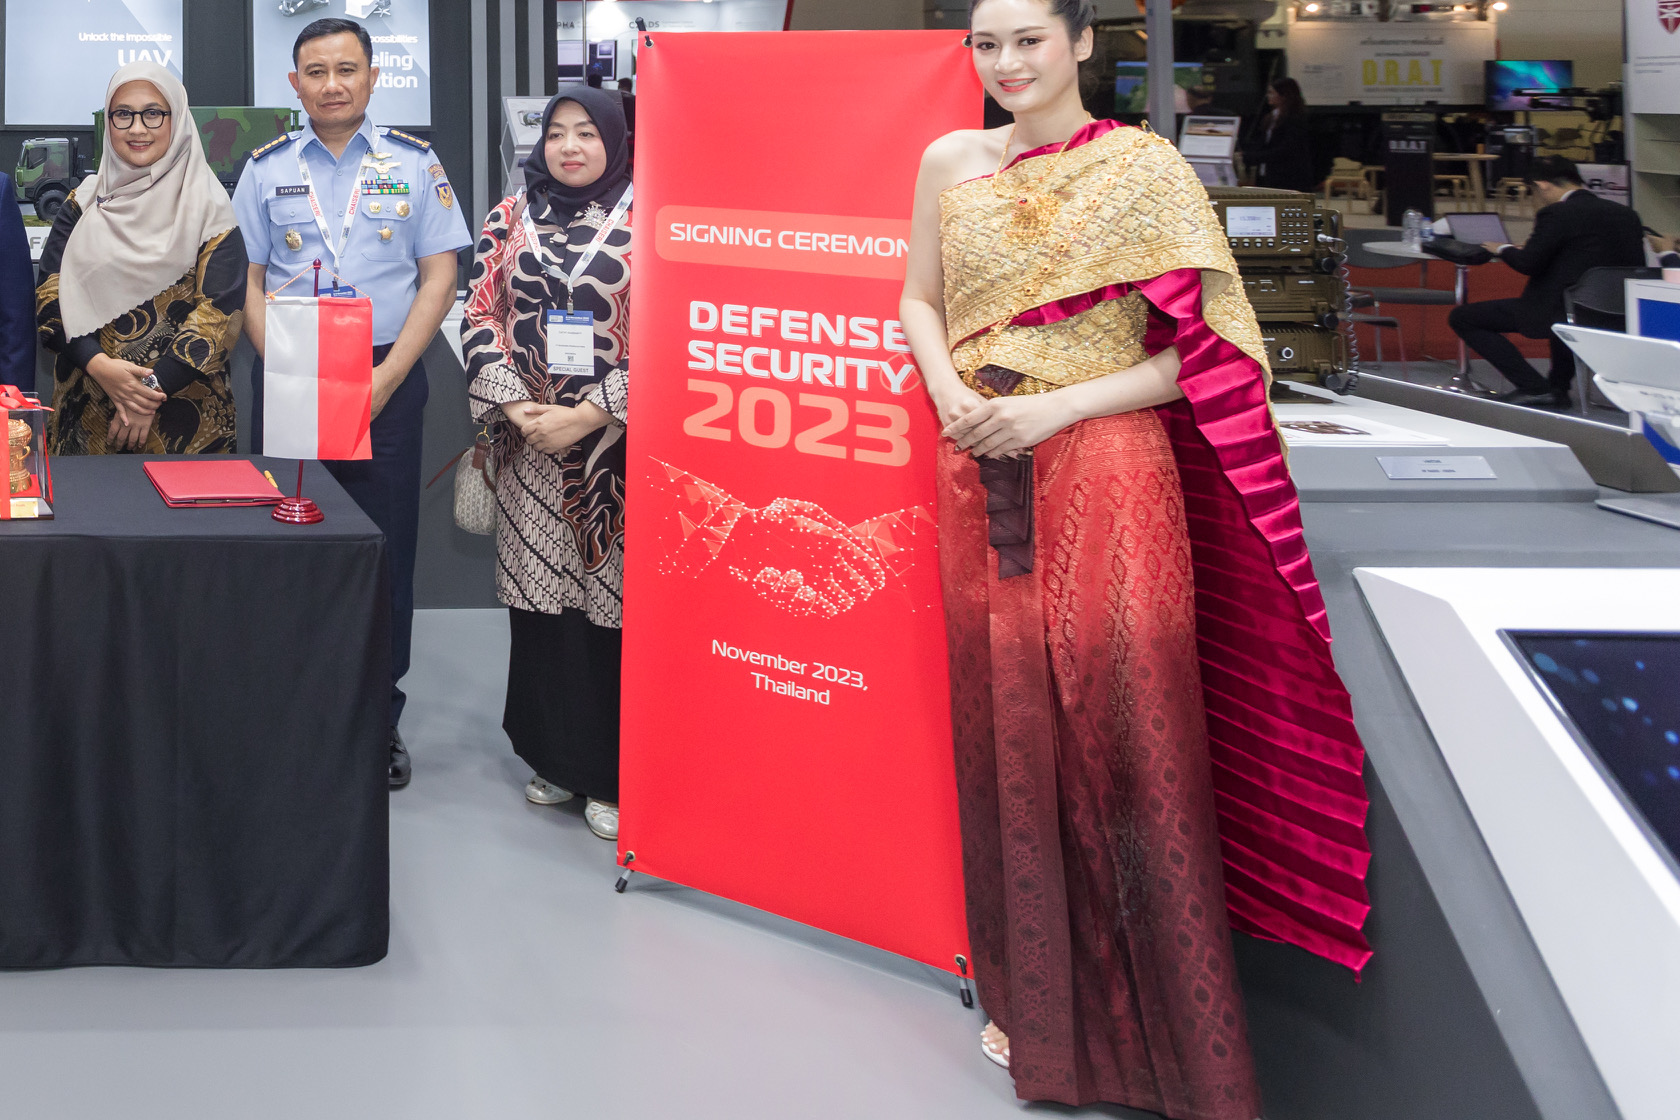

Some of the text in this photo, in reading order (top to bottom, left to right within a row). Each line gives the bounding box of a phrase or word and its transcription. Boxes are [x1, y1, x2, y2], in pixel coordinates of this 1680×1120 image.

[78, 32, 109, 42] Unlock
[110, 32, 125, 42] the
[117, 49, 173, 68] UAV
[371, 51, 414, 71] eling
[670, 222, 910, 258] SIGNING CEREMON
[689, 300, 913, 354] DEFENSE
[687, 339, 916, 396] SECURITY
[683, 378, 912, 468] 2023
[711, 639, 869, 692] November 2023,
[750, 670, 831, 706] Thailand
